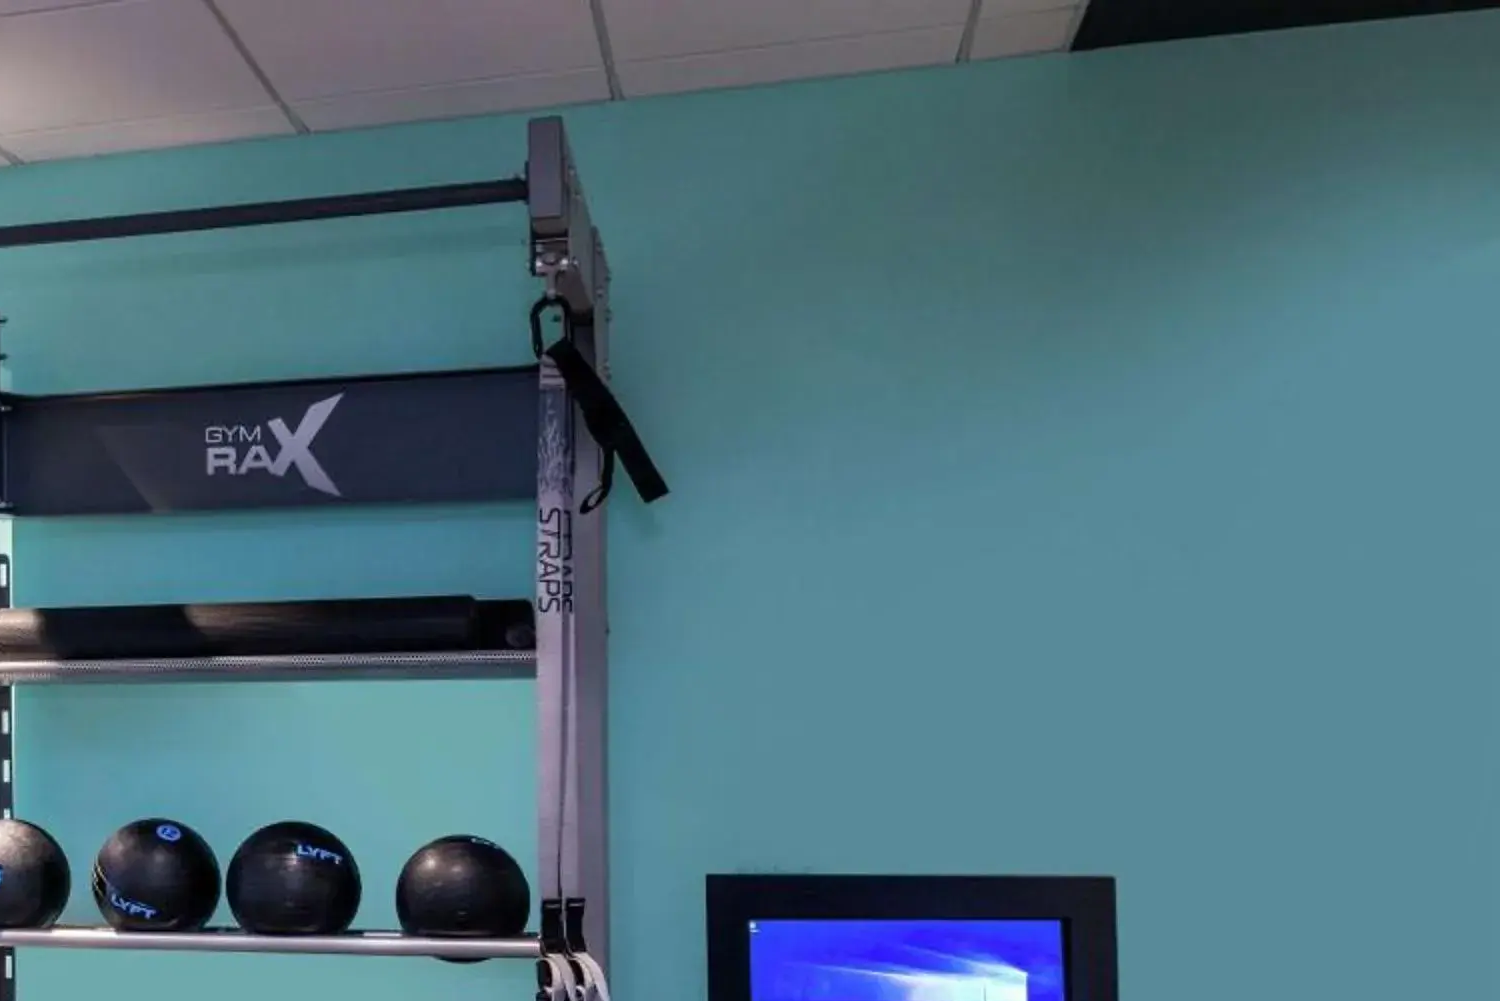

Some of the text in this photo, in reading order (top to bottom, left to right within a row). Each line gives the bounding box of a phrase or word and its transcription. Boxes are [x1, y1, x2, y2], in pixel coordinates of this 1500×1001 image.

[205, 425, 261, 443] GYM
[206, 392, 344, 497] RAX
[538, 507, 561, 613] STRAPS
[111, 893, 157, 919] LYFT
